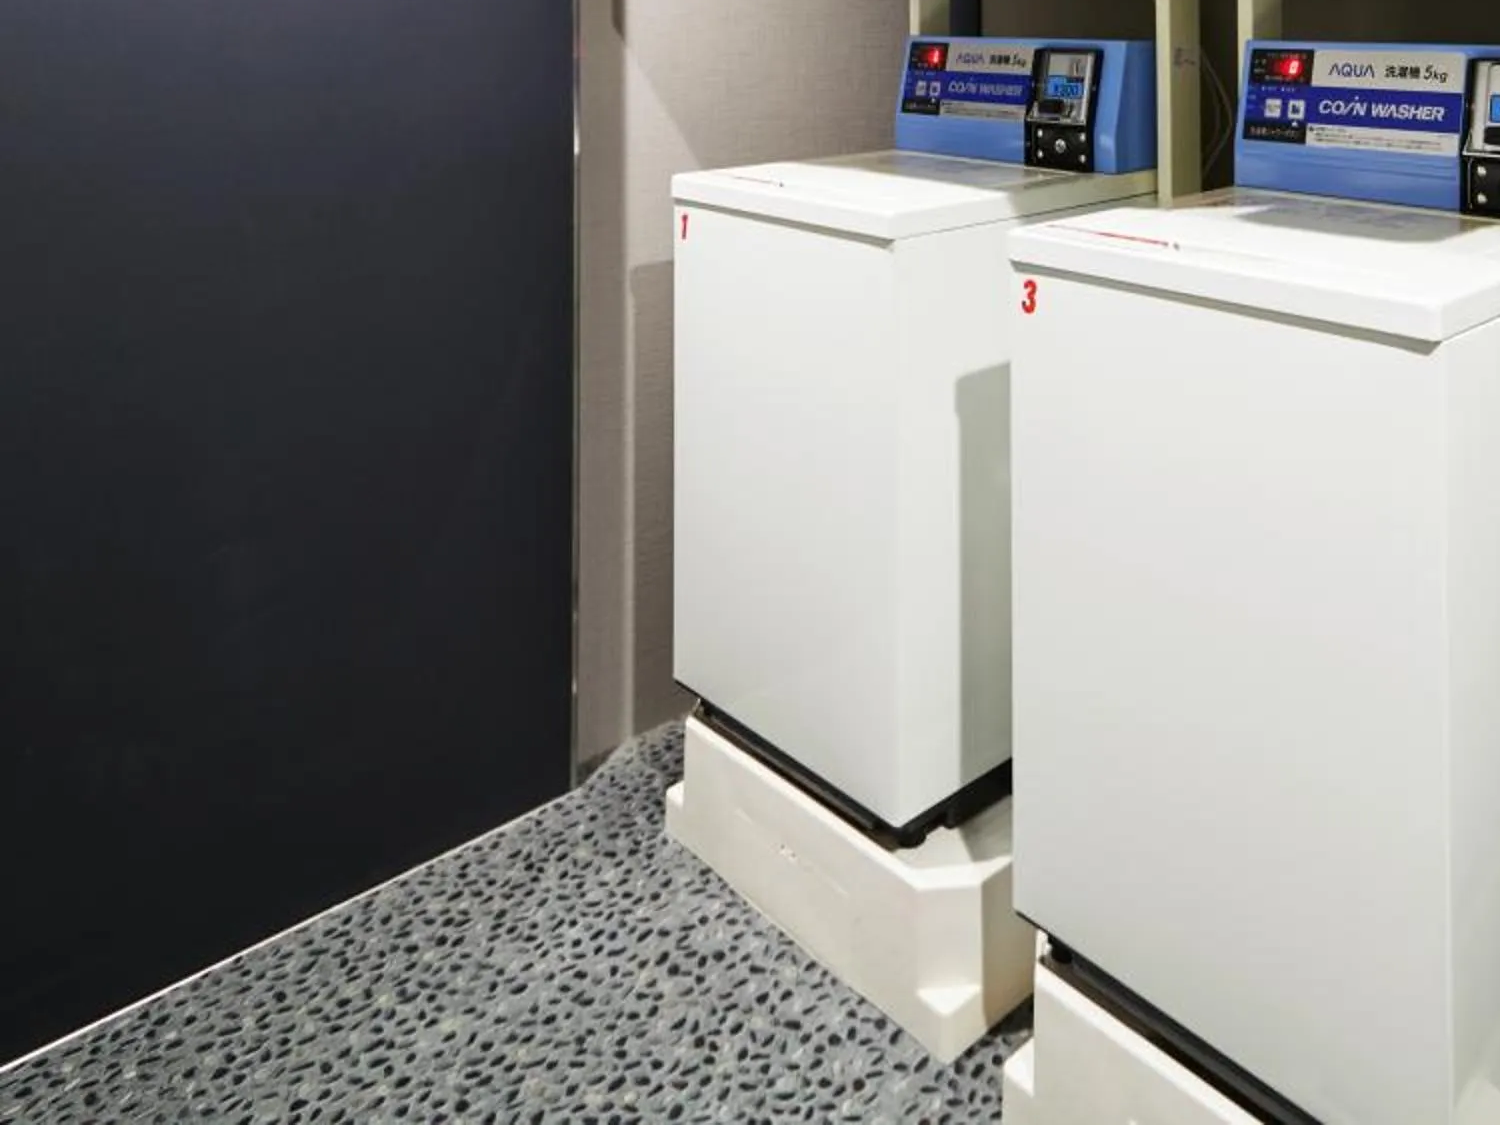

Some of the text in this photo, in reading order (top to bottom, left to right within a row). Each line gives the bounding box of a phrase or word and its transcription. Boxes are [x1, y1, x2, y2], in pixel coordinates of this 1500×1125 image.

[1328, 61, 1376, 78] AQUA
[1423, 66, 1449, 84] 5kg
[1371, 104, 1446, 123] WASHER
[681, 214, 688, 240] 1
[1021, 279, 1037, 314] 3
